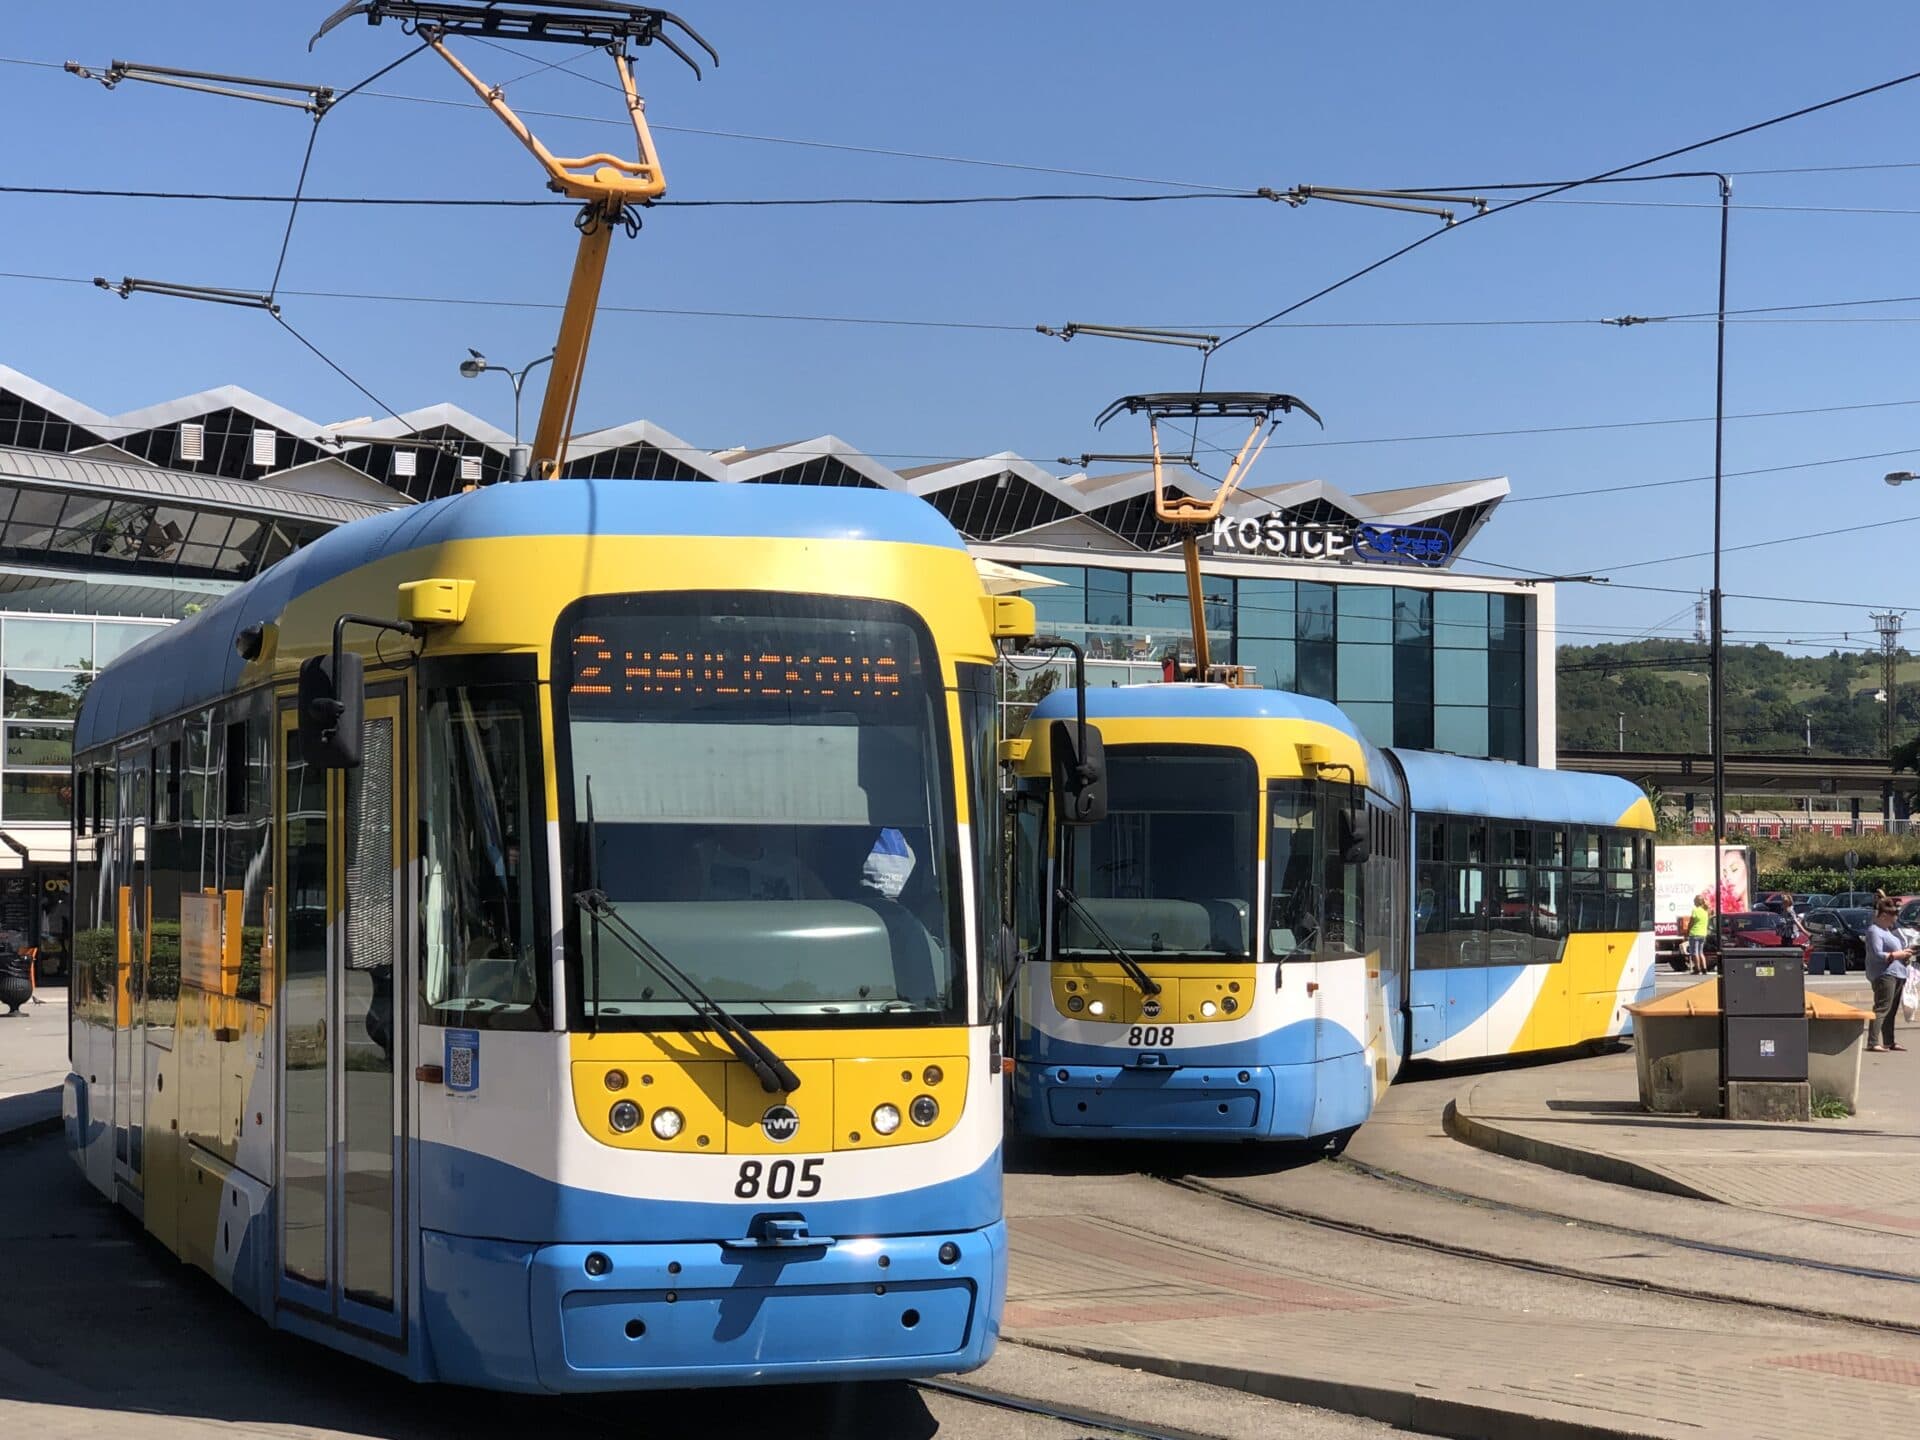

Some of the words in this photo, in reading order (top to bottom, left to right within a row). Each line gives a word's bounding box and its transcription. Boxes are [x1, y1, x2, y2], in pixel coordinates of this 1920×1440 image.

[1213, 511, 1345, 556] KOŠICE
[571, 634, 612, 694] 2
[1128, 1026, 1175, 1047] 808
[734, 1157, 825, 1200] 805
